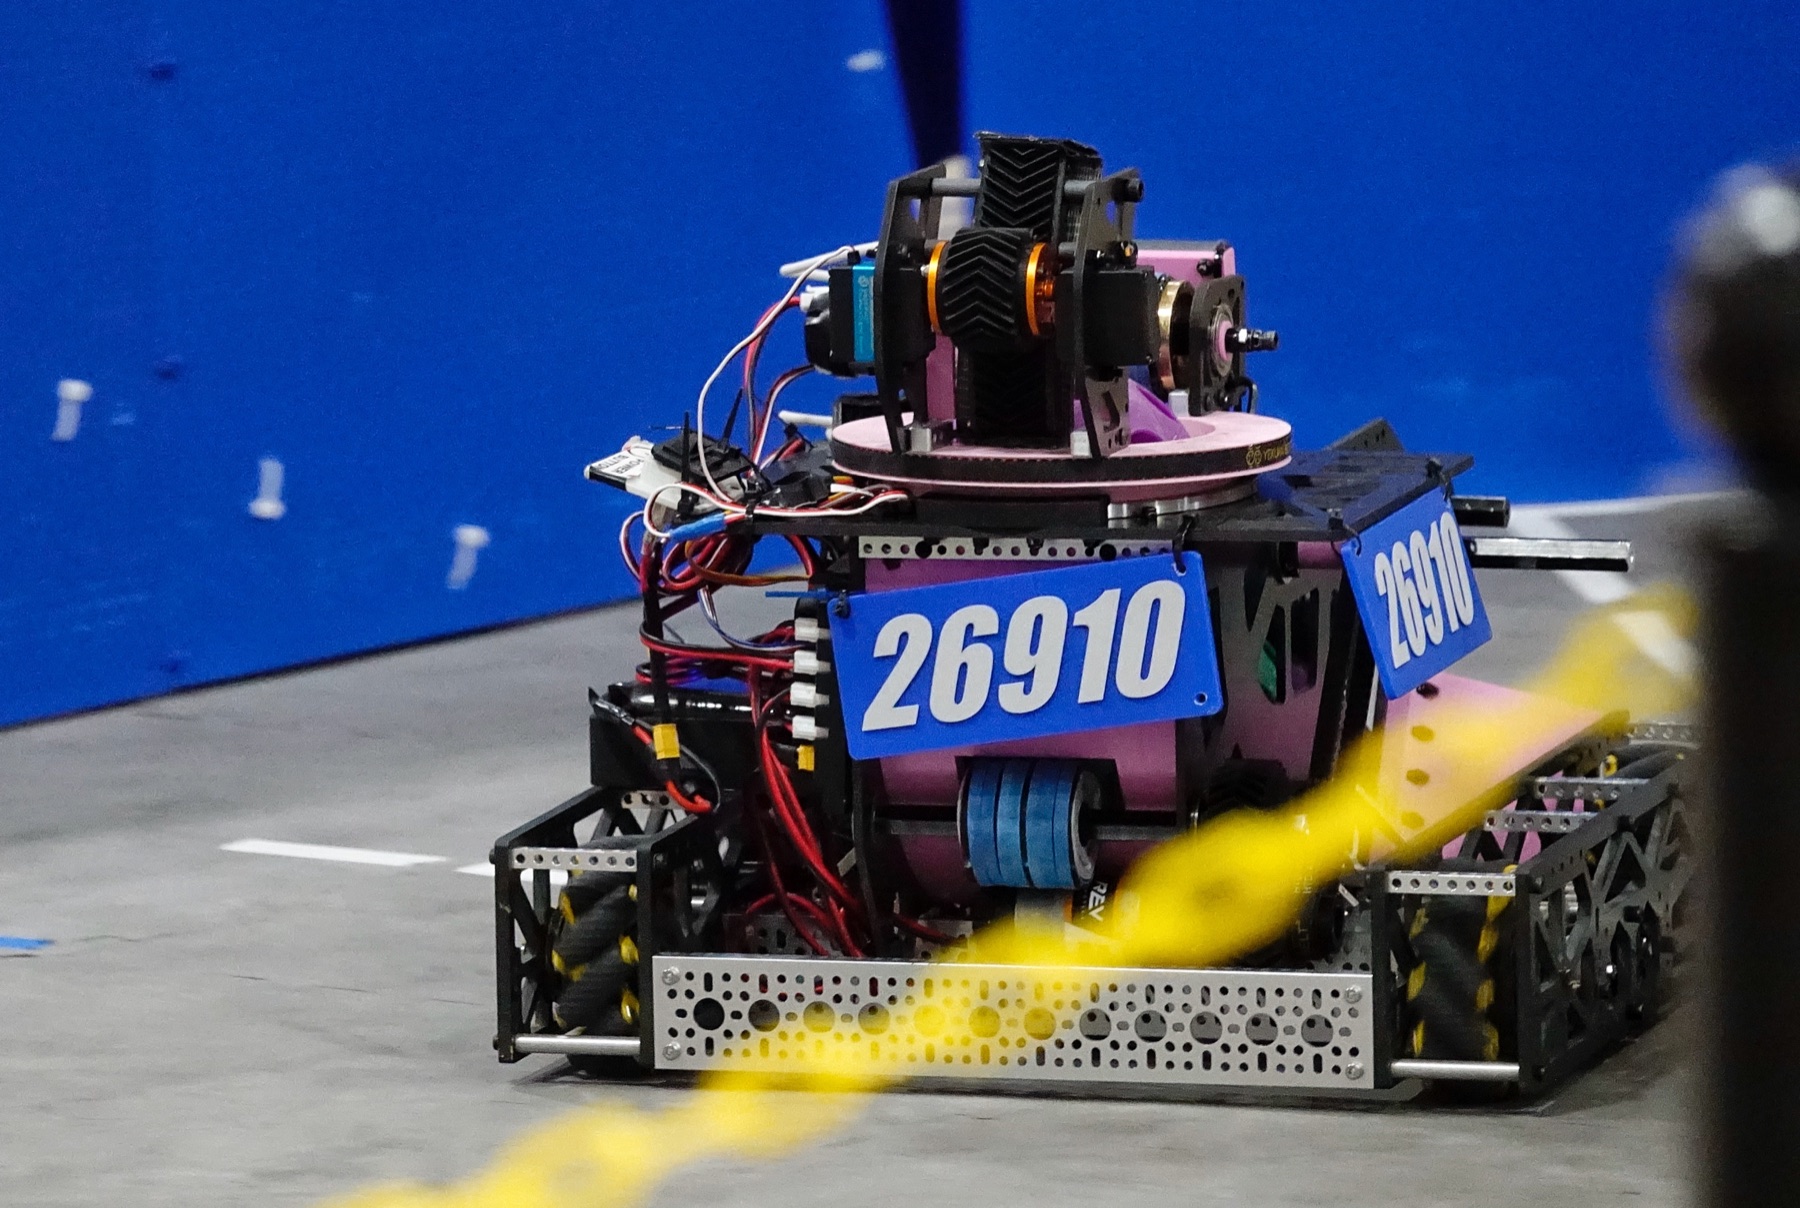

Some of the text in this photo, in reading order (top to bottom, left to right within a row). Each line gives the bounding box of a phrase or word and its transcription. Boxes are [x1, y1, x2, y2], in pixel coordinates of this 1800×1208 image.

[861, 579, 1186, 732] 26910
[1374, 511, 1475, 669] 26910
[1088, 881, 1109, 923] REV
